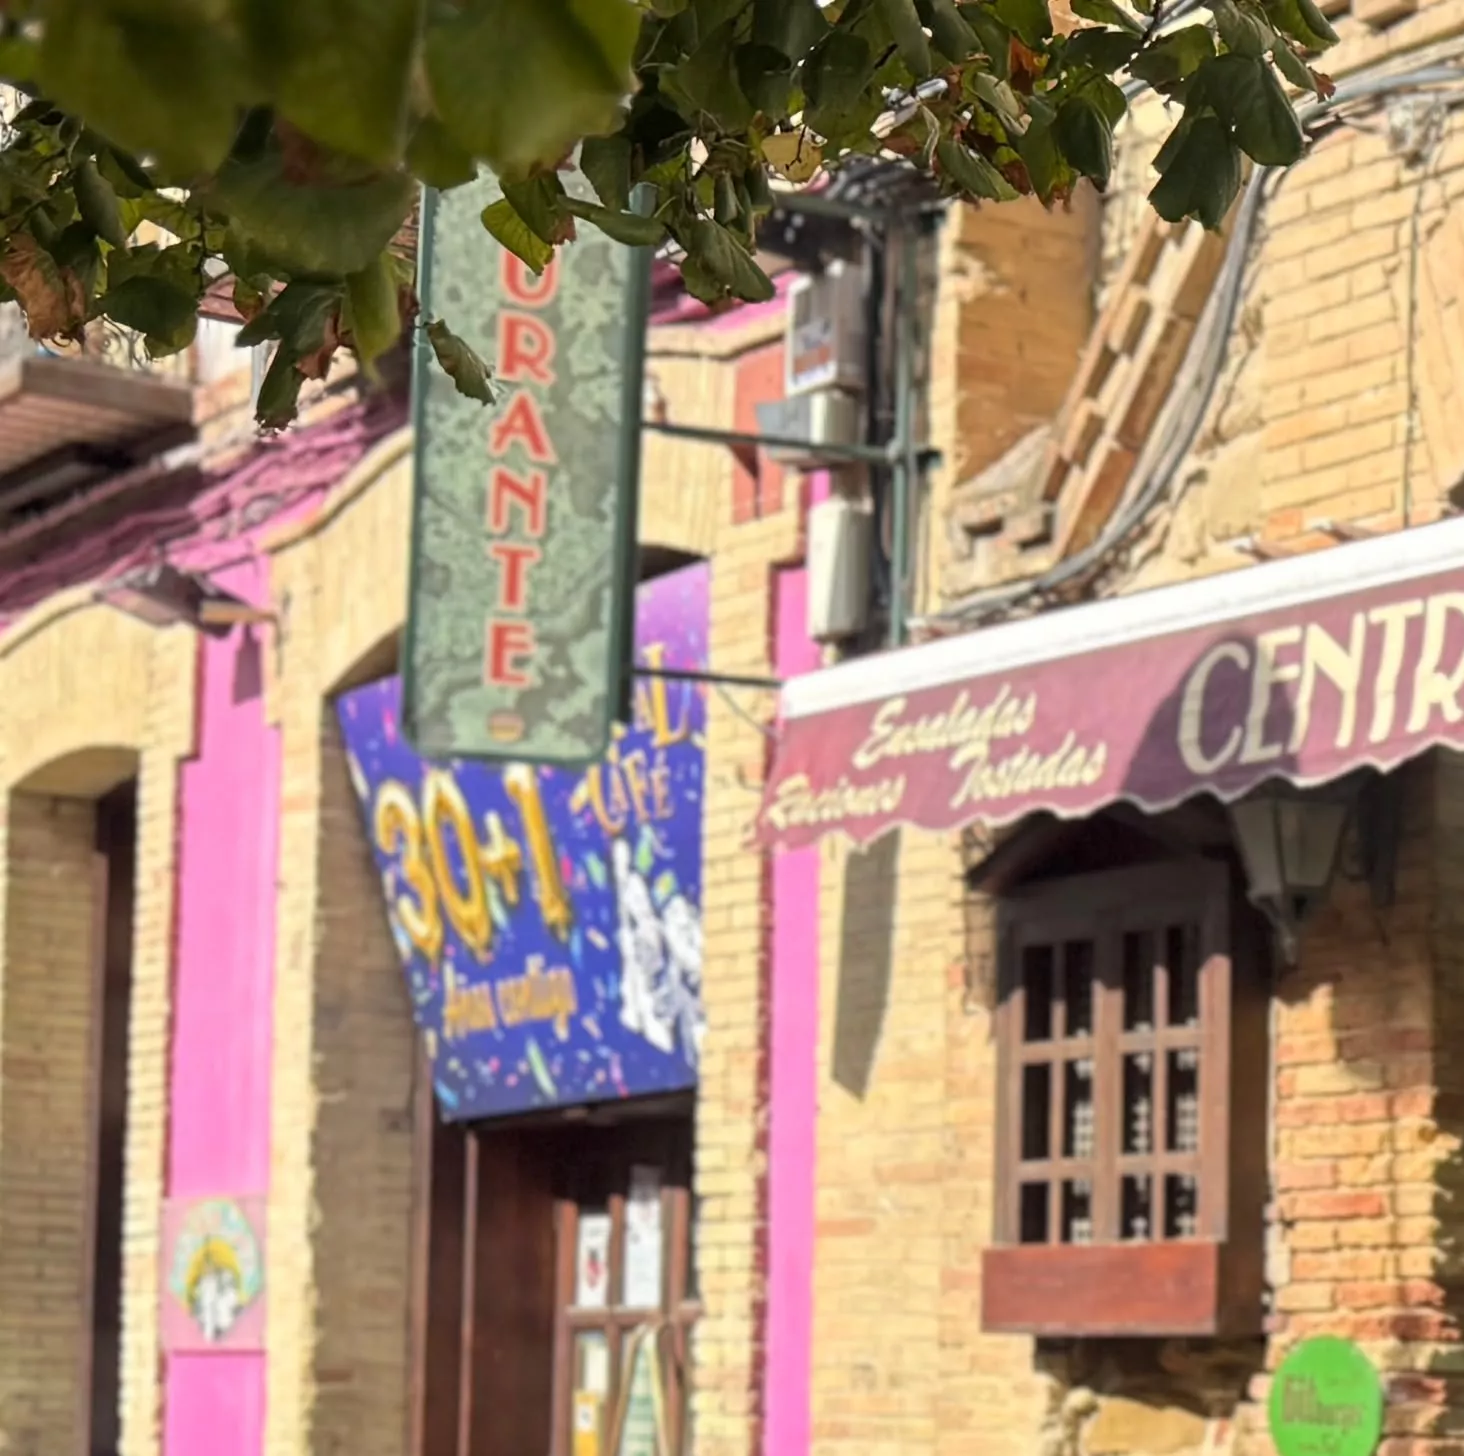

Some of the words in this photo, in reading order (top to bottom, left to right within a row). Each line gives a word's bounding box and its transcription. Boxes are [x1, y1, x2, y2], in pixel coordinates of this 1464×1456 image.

[852, 682, 1037, 770] Ensaladas
[948, 729, 1107, 809] Tostadas
[374, 760, 573, 964] 30+1
